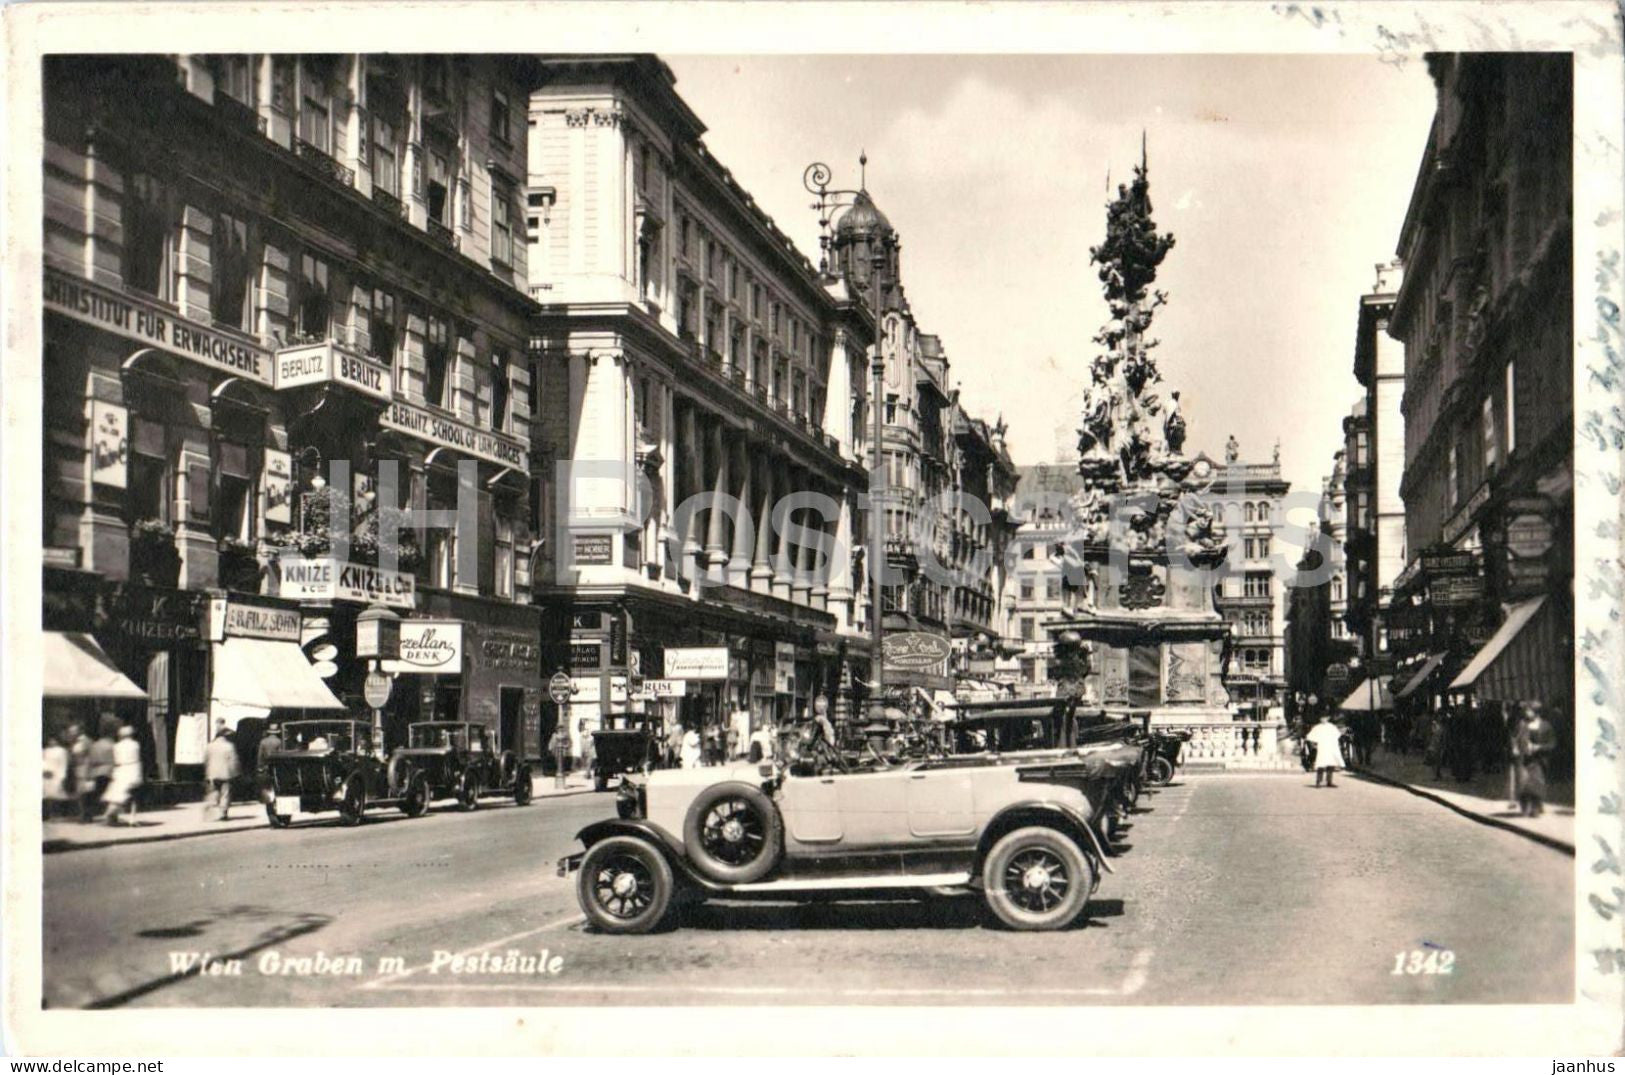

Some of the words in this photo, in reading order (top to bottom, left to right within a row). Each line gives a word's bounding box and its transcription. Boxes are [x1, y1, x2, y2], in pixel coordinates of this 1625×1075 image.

[173, 326, 261, 376] ERWACHSENE
[281, 356, 324, 378] BERLITZ
[341, 357, 382, 391] BERLITZ
[392, 404, 428, 433] BERLITZ
[432, 417, 465, 447] SCHOOL
[466, 431, 477, 450] OF
[269, 613, 298, 633] SOHN
[406, 651, 440, 659] DENK
